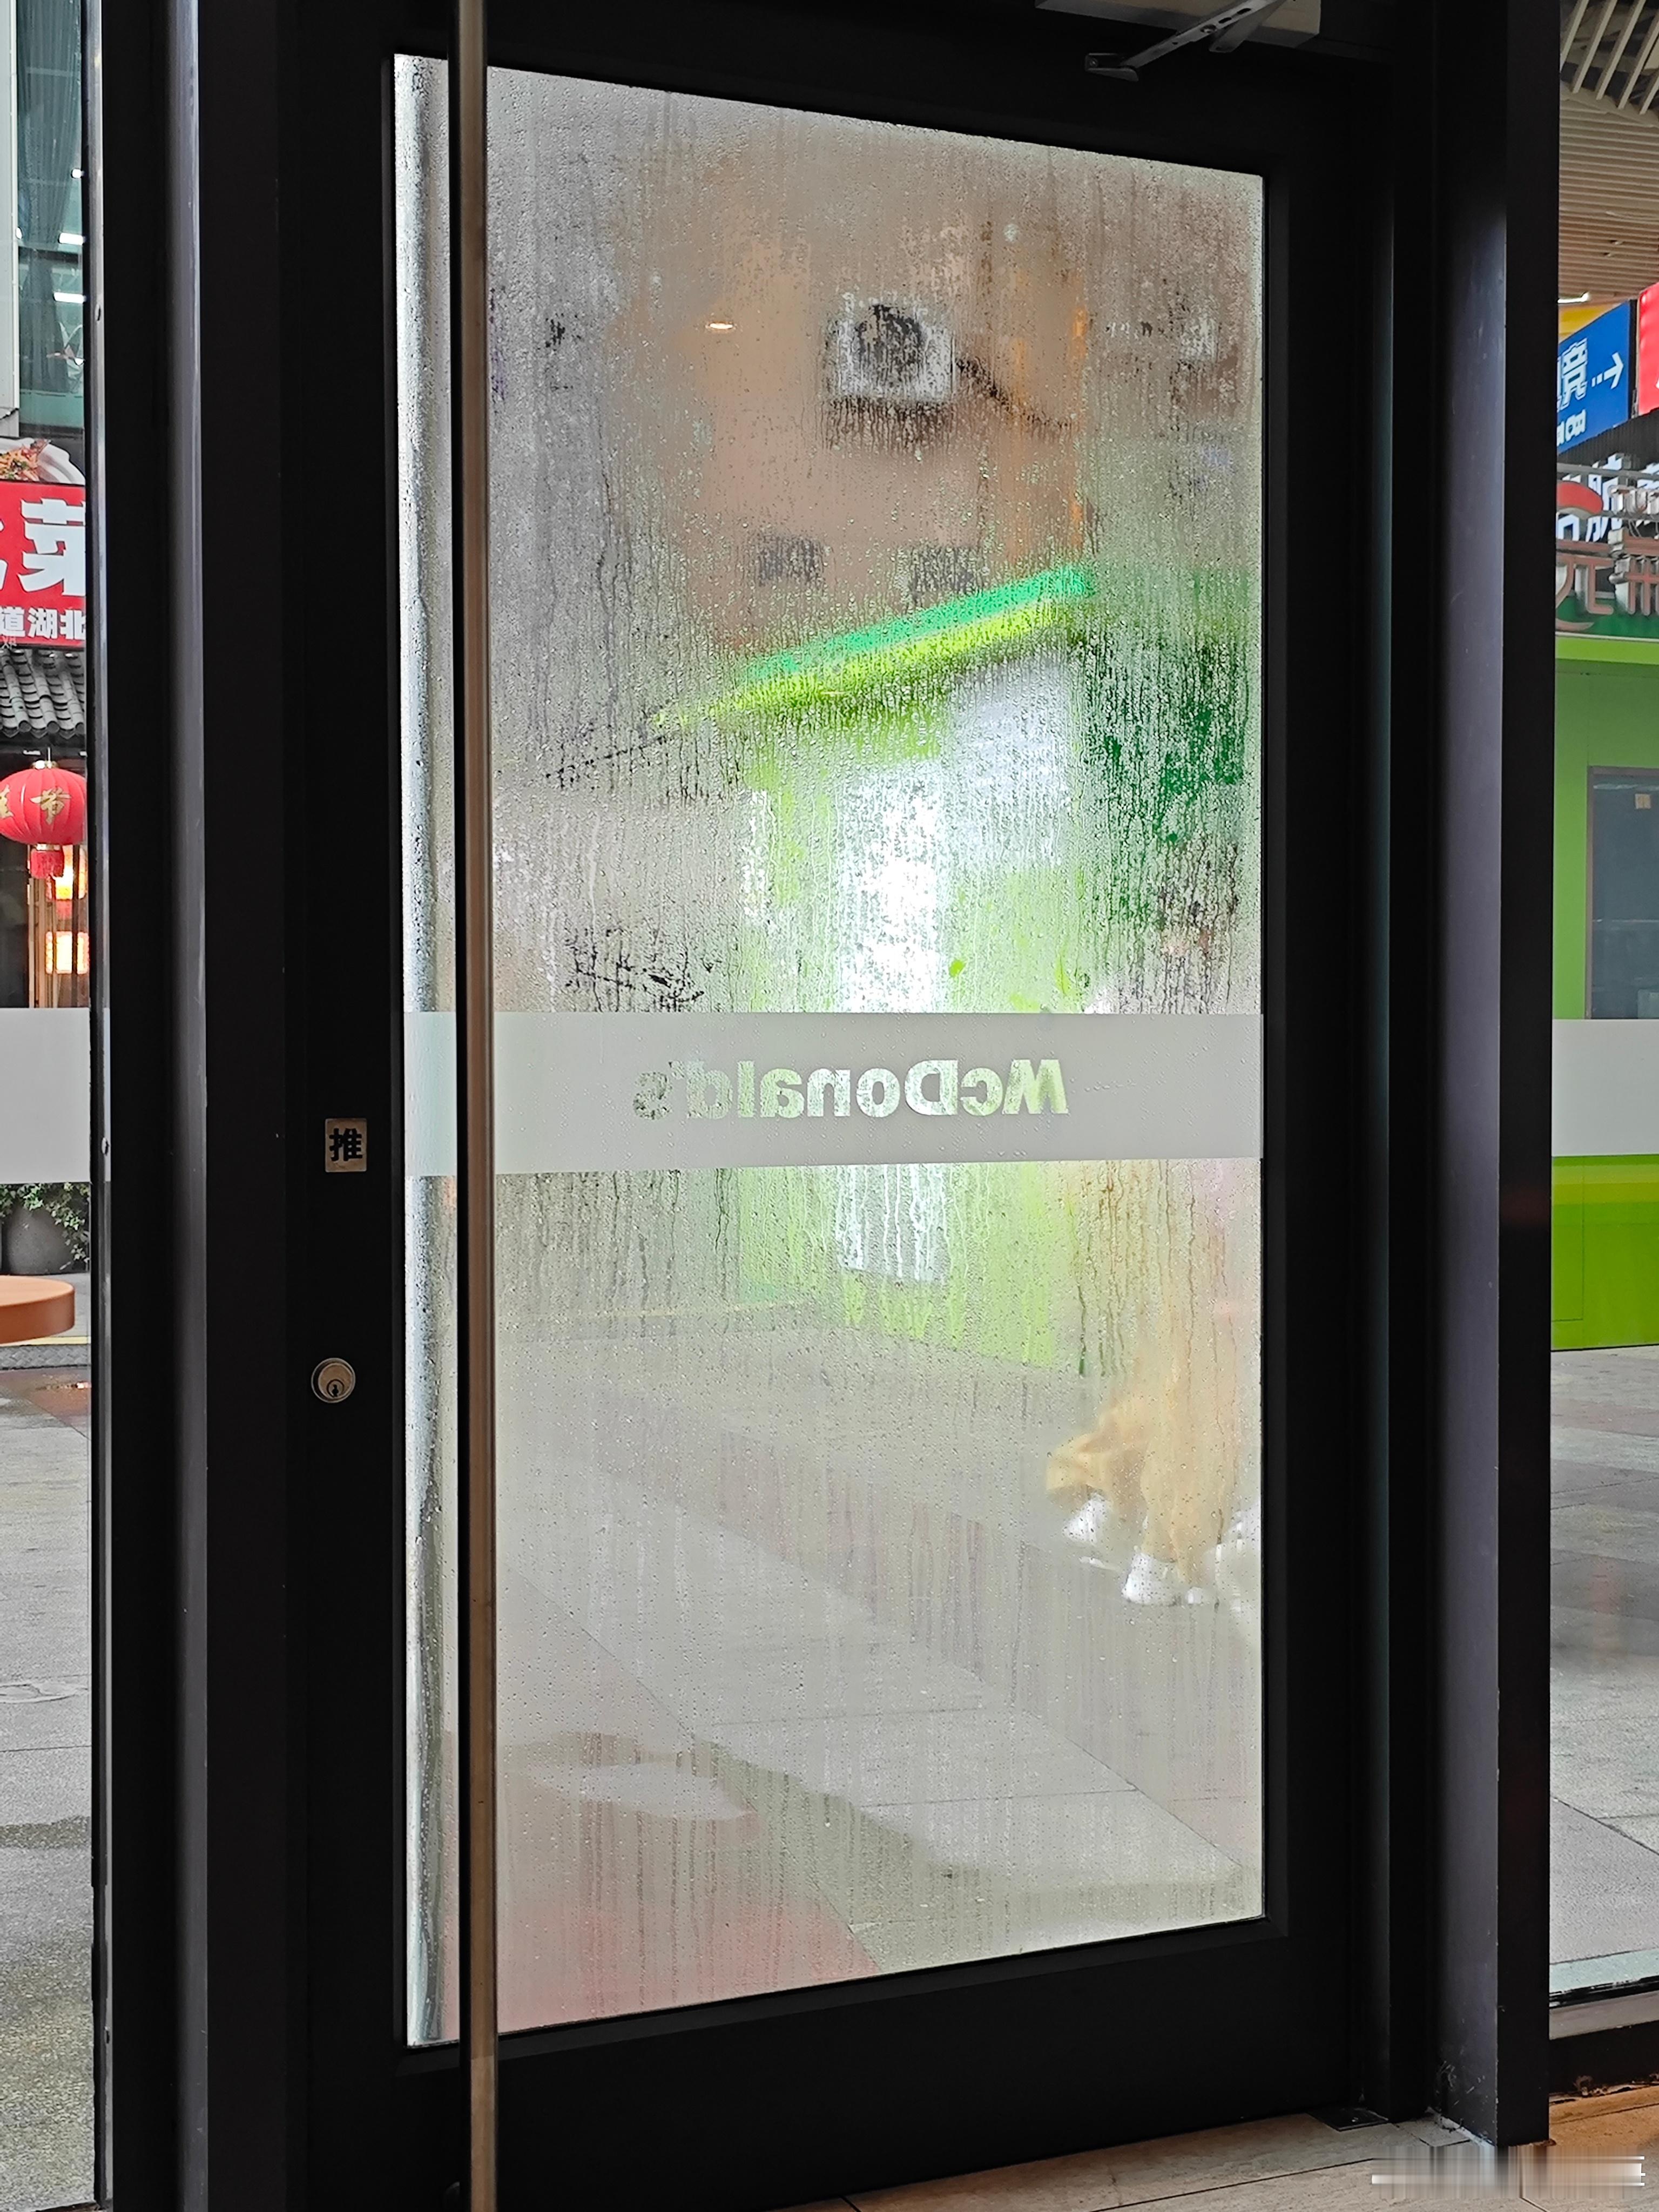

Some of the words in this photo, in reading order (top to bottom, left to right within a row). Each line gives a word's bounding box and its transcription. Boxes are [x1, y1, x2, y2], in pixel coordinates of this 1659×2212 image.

[0, 498, 86, 596] 菜
[0, 605, 86, 641] 道湖北
[329, 1128, 363, 1162] 推
